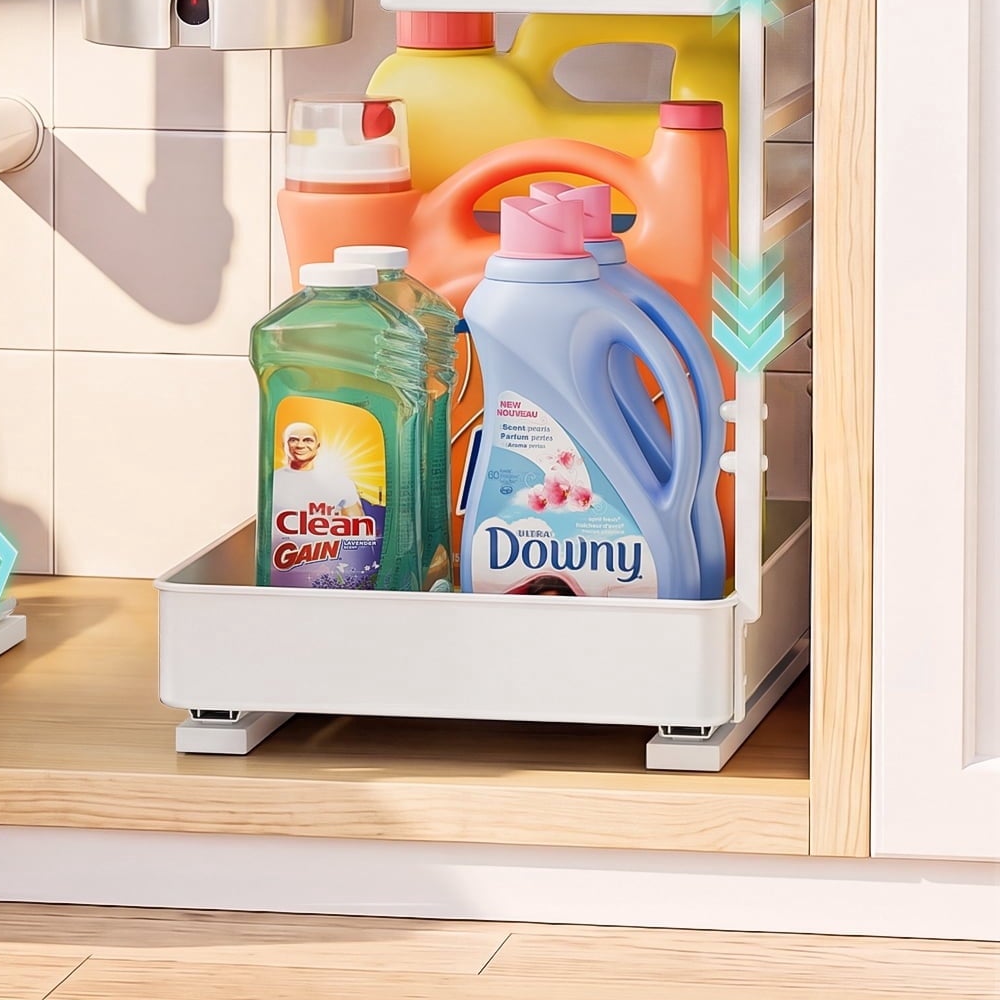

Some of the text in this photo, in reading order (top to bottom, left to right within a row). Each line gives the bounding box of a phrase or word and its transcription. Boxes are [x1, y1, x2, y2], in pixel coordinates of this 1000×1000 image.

[500, 401, 521, 409] NEW
[497, 409, 538, 418] NOUVEAU
[527, 425, 550, 433] pearls
[309, 502, 339, 516] Mr.
[276, 511, 374, 536] Clean
[517, 530, 551, 538] ULTRA
[273, 540, 340, 570] GAIN
[485, 527, 640, 583] Downy
